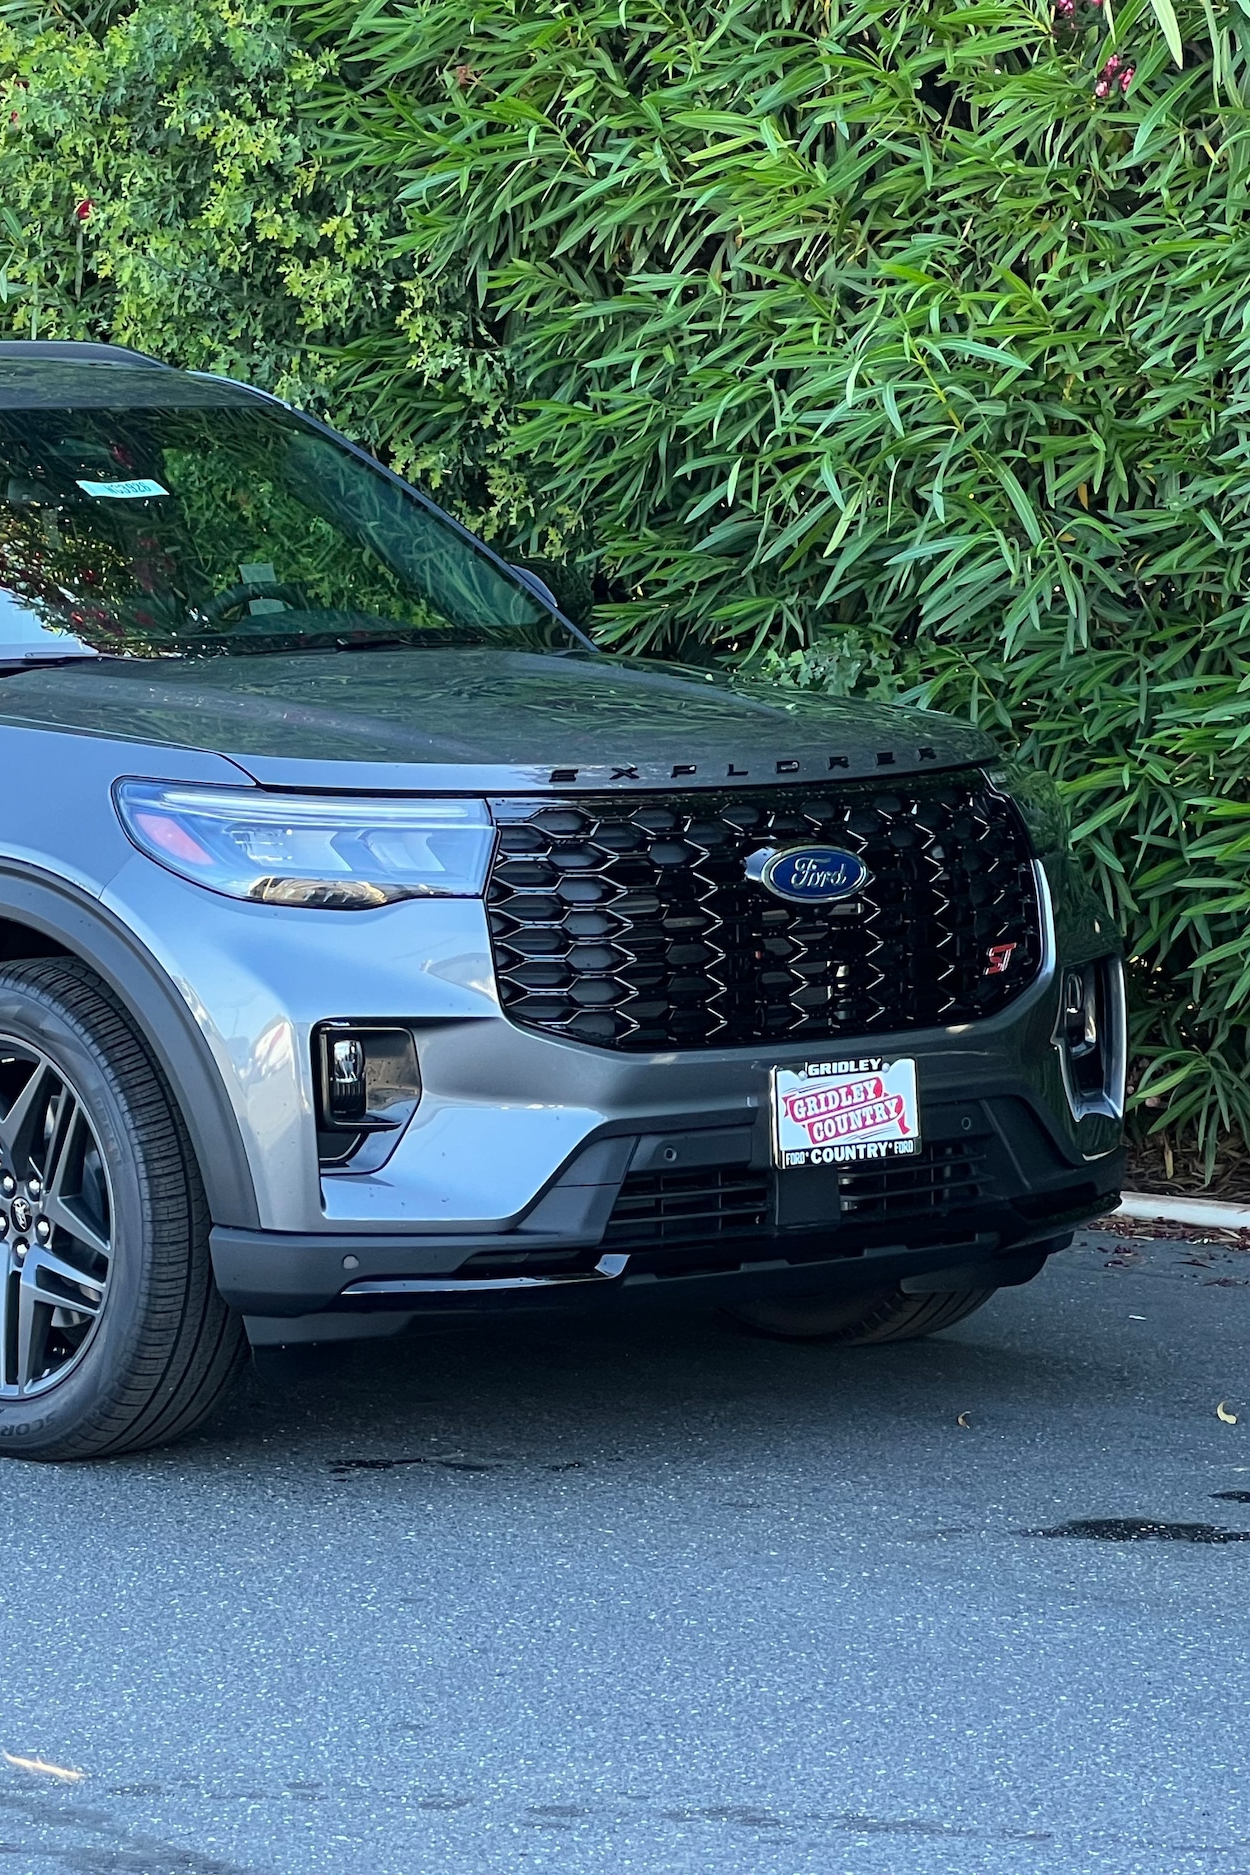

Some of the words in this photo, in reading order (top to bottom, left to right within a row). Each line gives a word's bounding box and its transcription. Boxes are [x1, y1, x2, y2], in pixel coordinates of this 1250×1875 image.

[549, 747, 937, 783] EXPLORER
[790, 856, 848, 889] Ford
[982, 942, 1018, 976] ST
[807, 1057, 882, 1077] GRIDLEY
[793, 1079, 878, 1120] GRIDLEY
[812, 1097, 900, 1142] COUNTRY
[786, 1151, 806, 1166] FORD
[810, 1141, 888, 1164] COUNTRY
[894, 1139, 914, 1155] FORD
